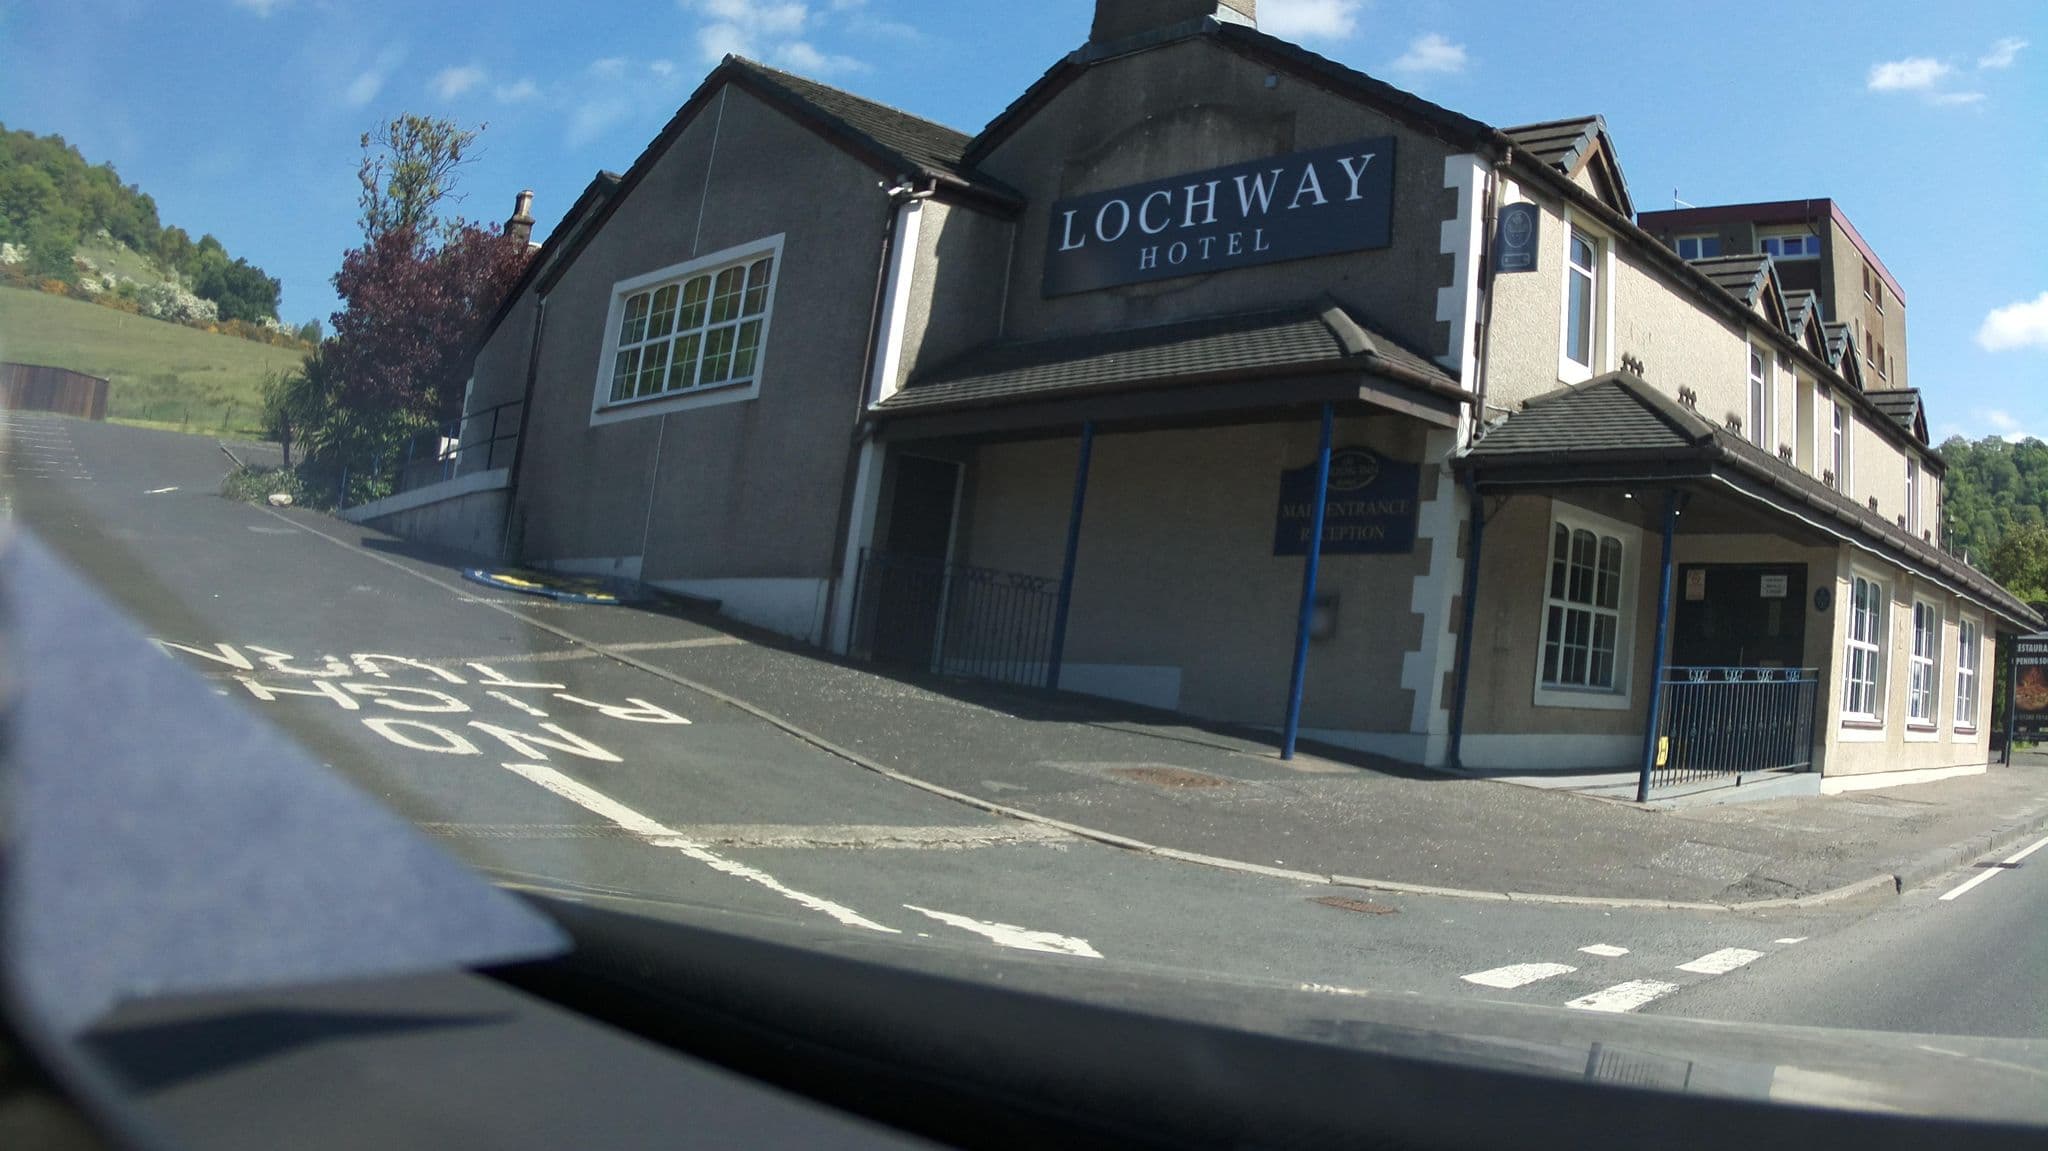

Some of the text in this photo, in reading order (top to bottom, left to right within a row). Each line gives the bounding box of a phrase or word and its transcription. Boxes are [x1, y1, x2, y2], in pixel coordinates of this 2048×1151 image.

[1058, 153, 1377, 252] LOCHWAY
[1139, 227, 1272, 271] HOTEL
[1282, 499, 1408, 518] MAI ENTRANCE
[1299, 525, 1385, 541] RCEPTION
[2011, 656, 2039, 665] PENING
[214, 673, 693, 726] RIGH
[361, 717, 624, 763] NO
